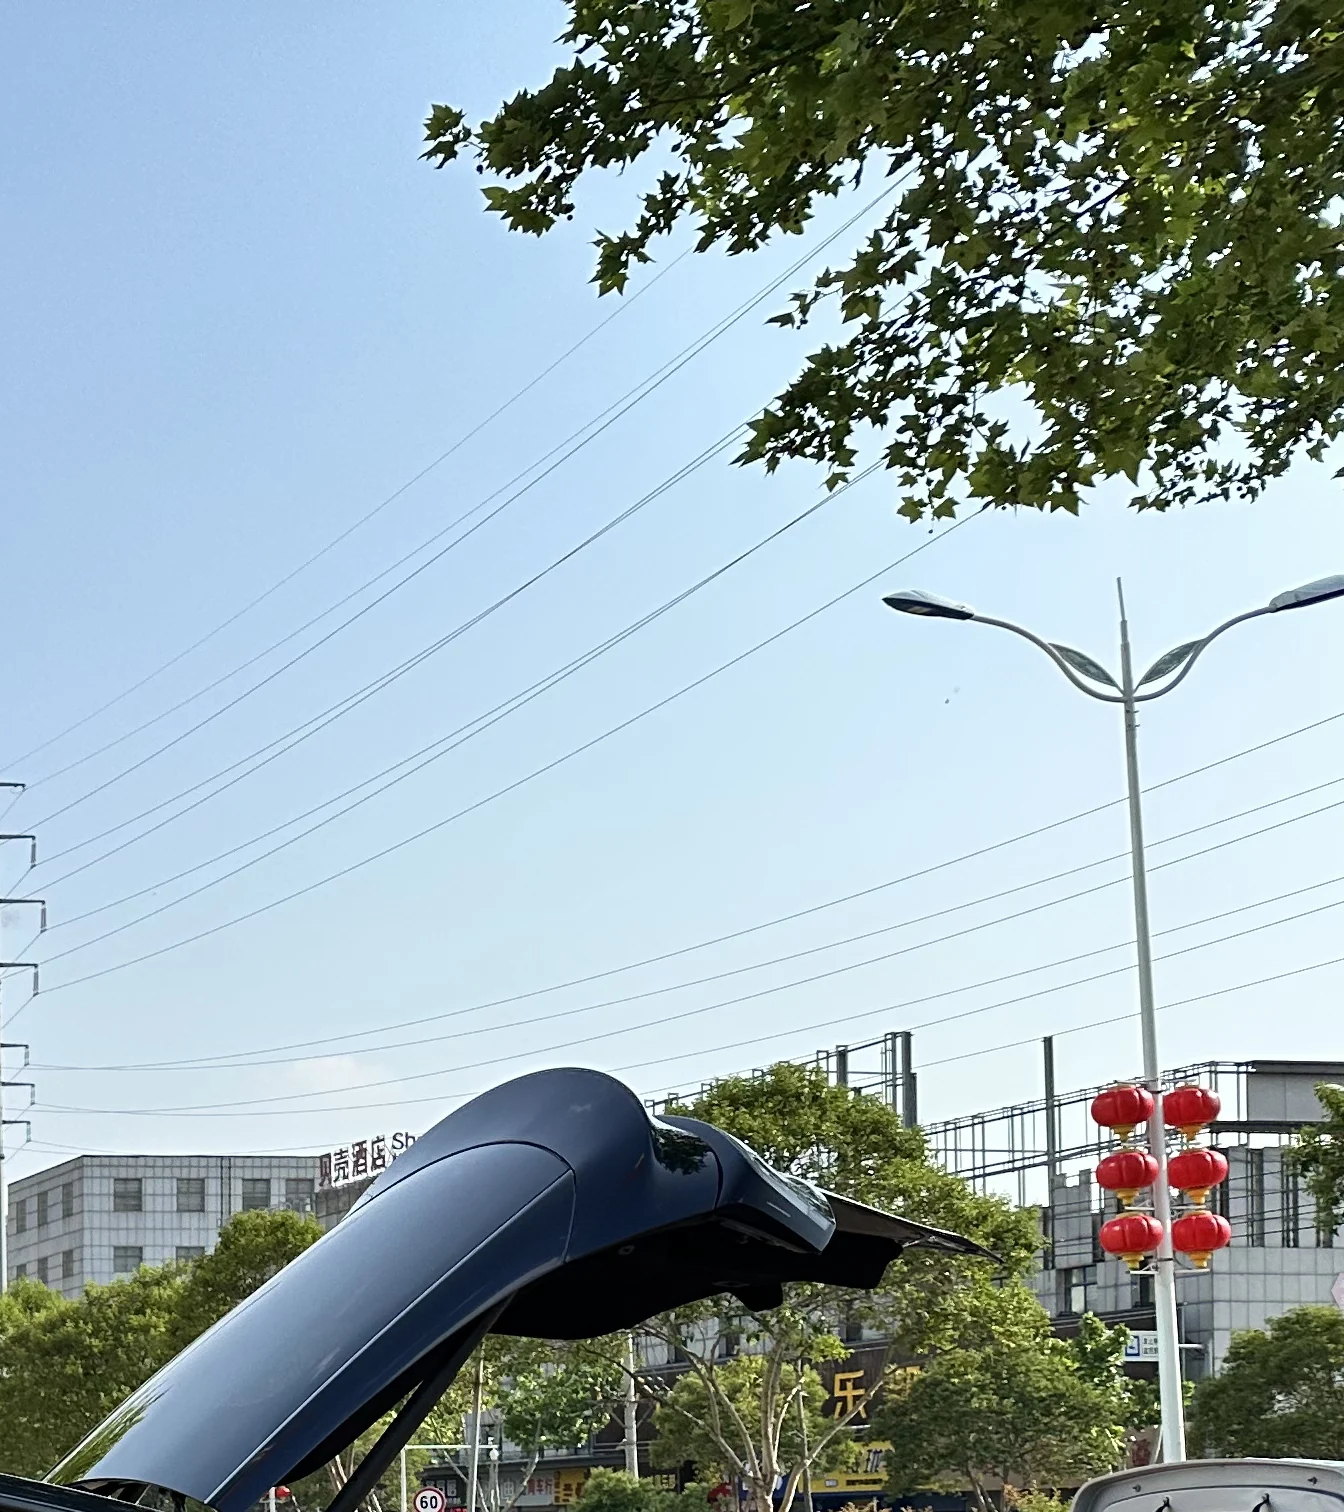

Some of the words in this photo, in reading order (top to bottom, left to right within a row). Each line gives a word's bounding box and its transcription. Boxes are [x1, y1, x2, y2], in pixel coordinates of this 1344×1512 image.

[319, 1134, 386, 1187] 贝壳酒店
[833, 1369, 866, 1420] 乐
[420, 1495, 438, 1510] 60
